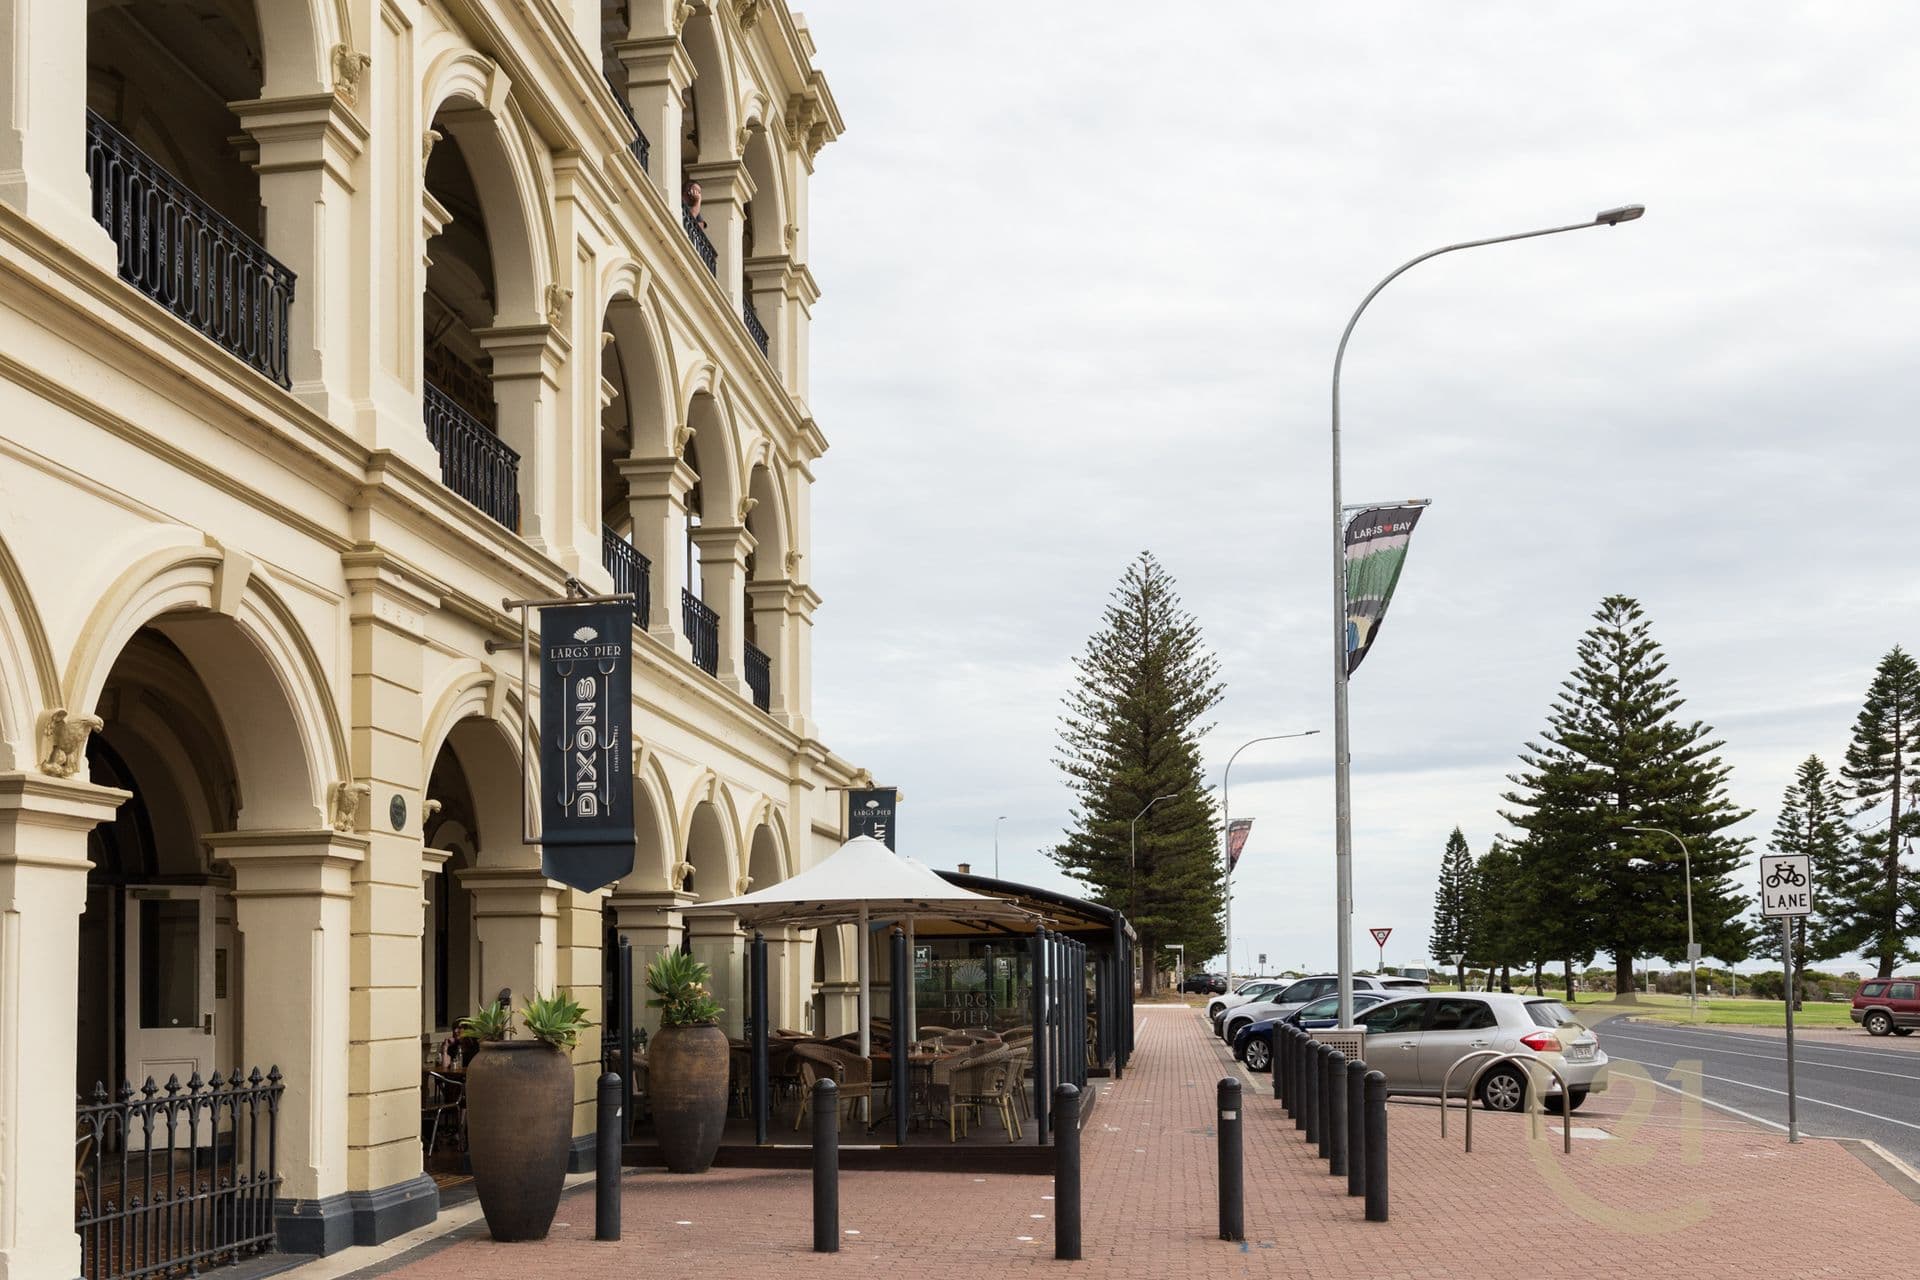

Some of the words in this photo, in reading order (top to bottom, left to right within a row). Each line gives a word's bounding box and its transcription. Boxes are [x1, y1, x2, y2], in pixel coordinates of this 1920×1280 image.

[1392, 521, 1411, 532] BAY
[551, 646, 589, 659] LARGS
[594, 645, 621, 657] PIER
[576, 676, 598, 818] DIXONS
[1767, 893, 1807, 909] LANE
[943, 992, 997, 1008] LARGS
